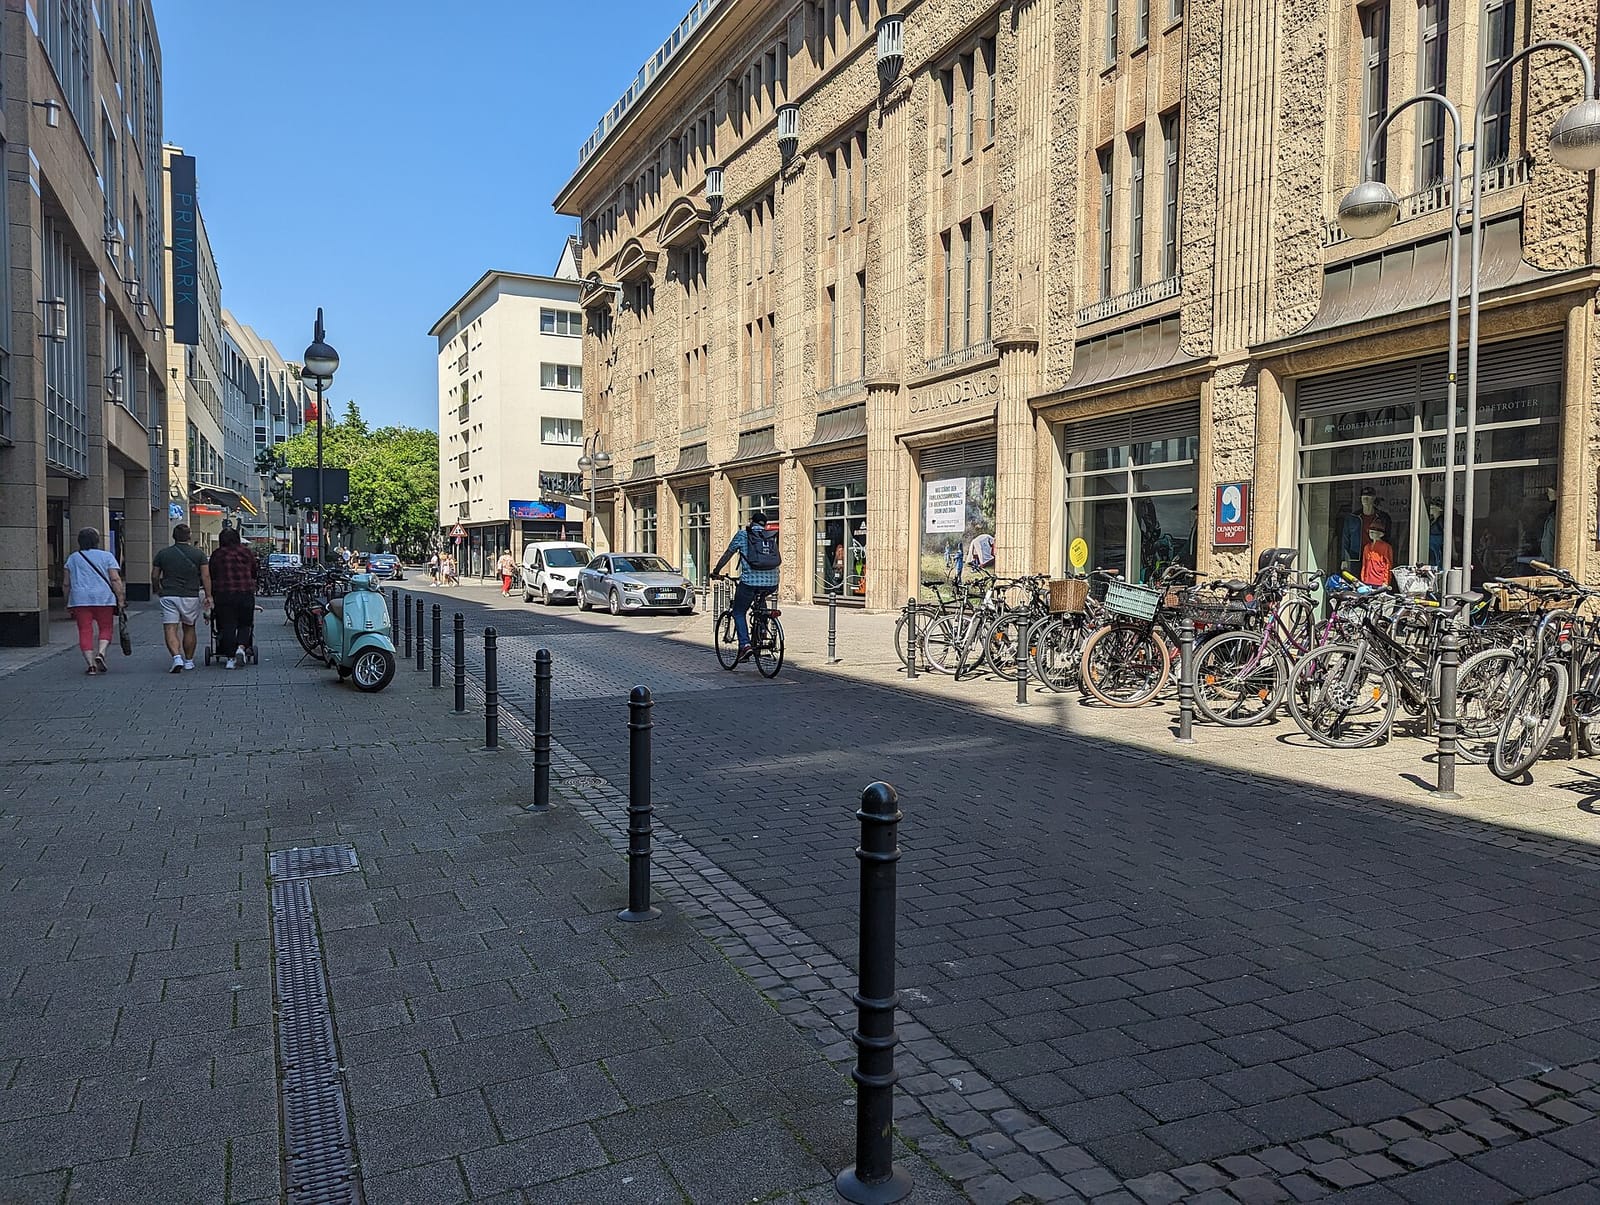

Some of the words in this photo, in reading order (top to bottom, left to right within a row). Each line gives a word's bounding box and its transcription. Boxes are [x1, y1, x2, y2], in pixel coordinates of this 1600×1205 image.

[175, 192, 194, 305] PRIMARK
[908, 374, 999, 414] OLIVANDENHO
[1477, 398, 1539, 413] OBETROTTER
[1337, 418, 1394, 431] GLOBETROTTER
